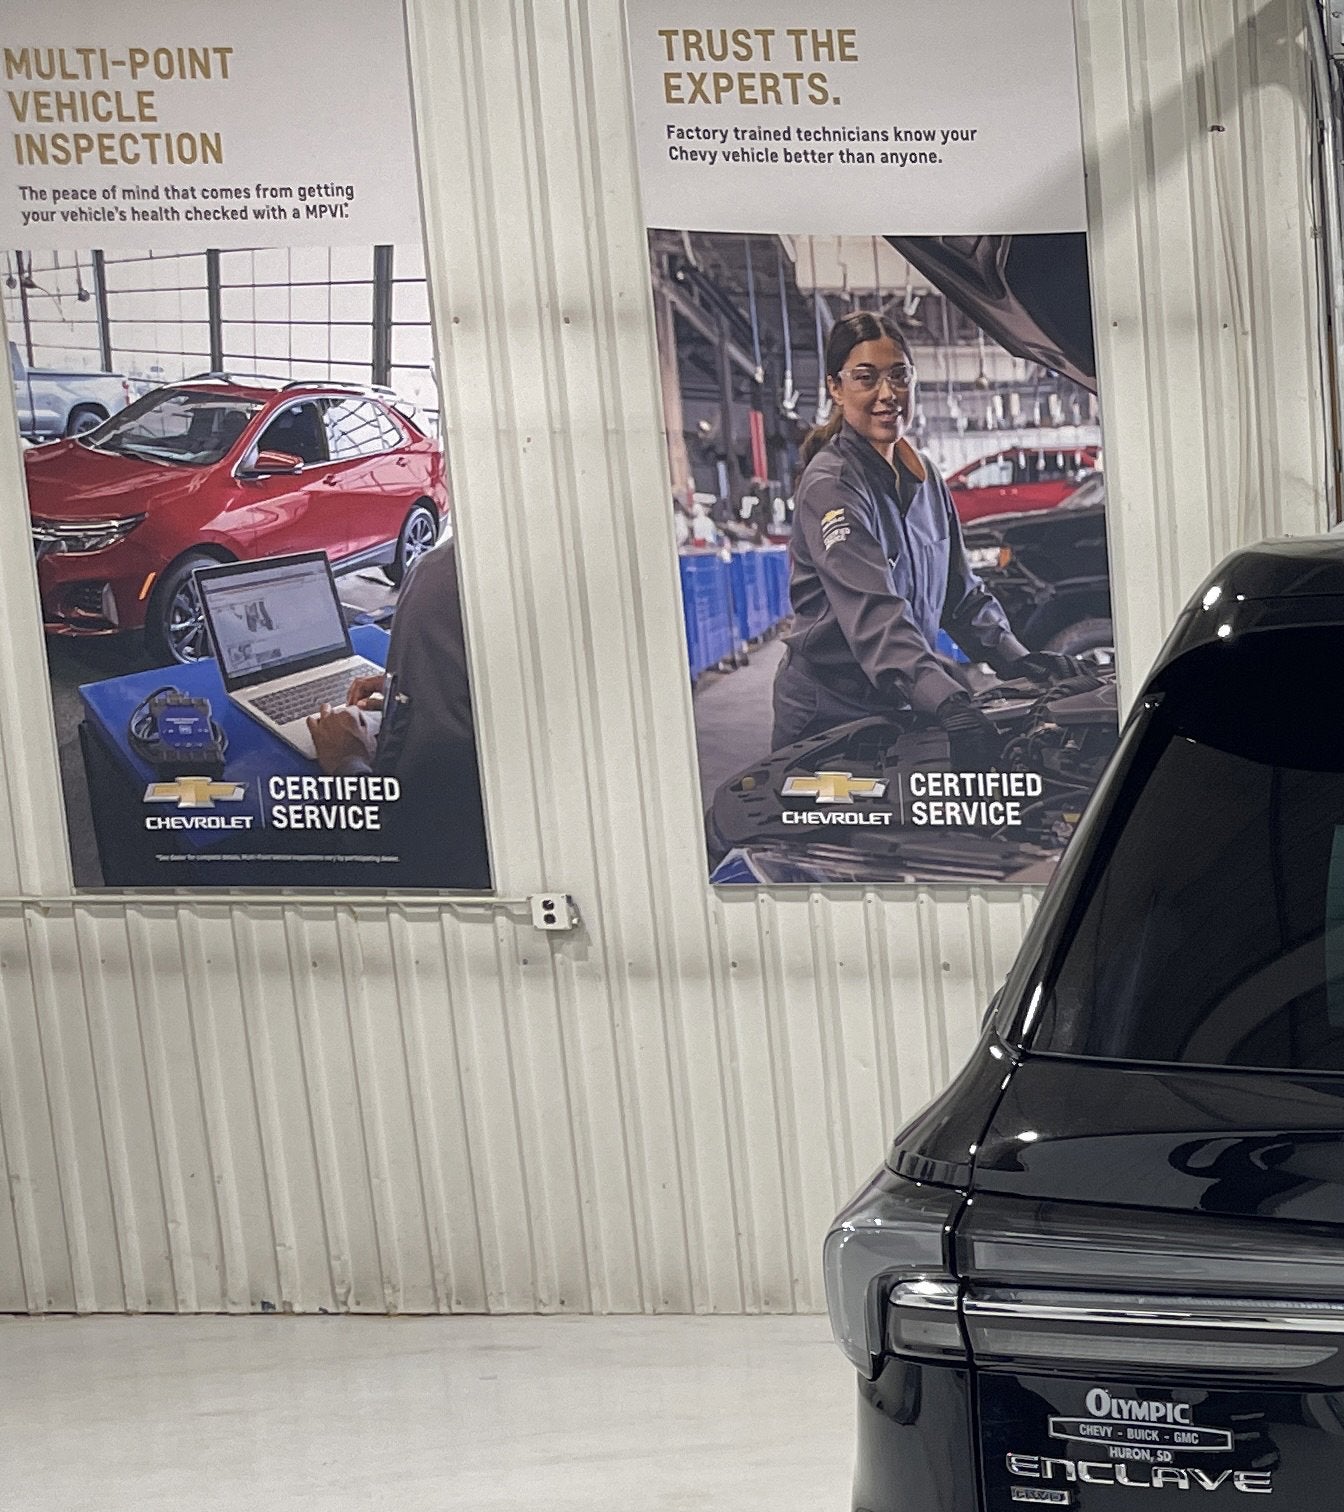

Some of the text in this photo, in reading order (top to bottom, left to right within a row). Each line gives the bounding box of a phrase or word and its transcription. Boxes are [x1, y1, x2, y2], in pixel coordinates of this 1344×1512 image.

[658, 28, 859, 62] TRUST THE
[4, 46, 234, 81] MULTI-POINT
[664, 72, 842, 106] EXPERTS.
[8, 90, 157, 123] VEHICLE
[666, 124, 978, 144] Factory trained technicians know your
[14, 132, 224, 165] INSPECTION
[669, 146, 943, 167] Chevy vehicle better than anyone.
[19, 182, 354, 204] The peace of mind that comes from getting
[22, 210, 57, 225] your
[60, 206, 127, 222] vehicle's
[131, 205, 180, 221] health
[185, 204, 248, 220] checked
[252, 204, 287, 219] with
[292, 207, 300, 219] a
[269, 776, 400, 802] CERTIFIED
[910, 772, 1042, 798] CERTIFIED
[145, 816, 254, 830] CHEVROLET
[272, 804, 381, 830] SERVICE
[782, 811, 892, 825] CHEVROLET
[911, 801, 1022, 826] SERVICE
[1079, 1423, 1113, 1438] CHEVY
[1127, 1427, 1160, 1442] BUICK
[1174, 1431, 1199, 1445] GMC
[1109, 1445, 1173, 1463] HURON, SD
[1006, 1452, 1273, 1494] ENCLAVE
